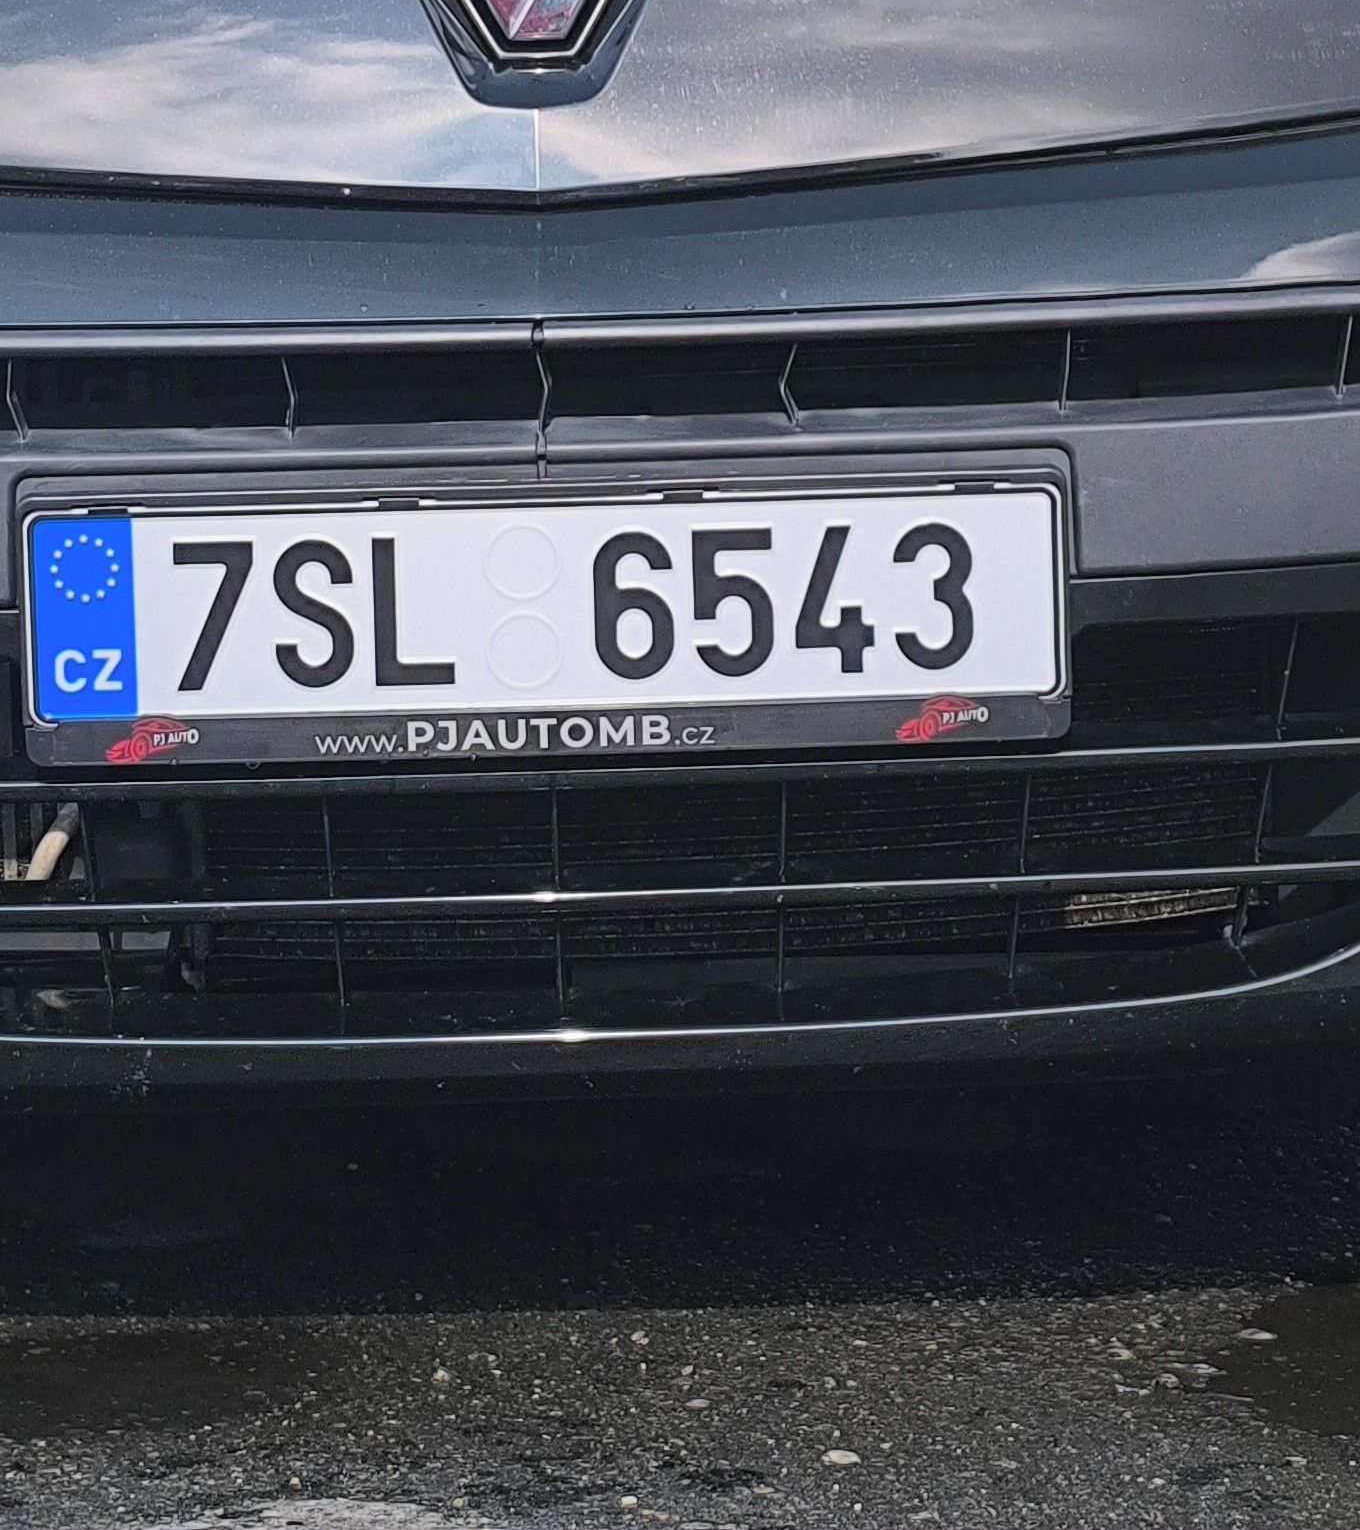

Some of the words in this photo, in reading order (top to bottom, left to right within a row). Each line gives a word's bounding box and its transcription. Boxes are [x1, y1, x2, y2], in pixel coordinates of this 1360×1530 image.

[172, 537, 456, 692] 7SL
[592, 523, 974, 680] 6543
[54, 648, 124, 693] CZ
[314, 714, 716, 754] www.PJAUTOMB.cz
[956, 706, 989, 723] AUTO
[167, 728, 200, 745] AUTO
